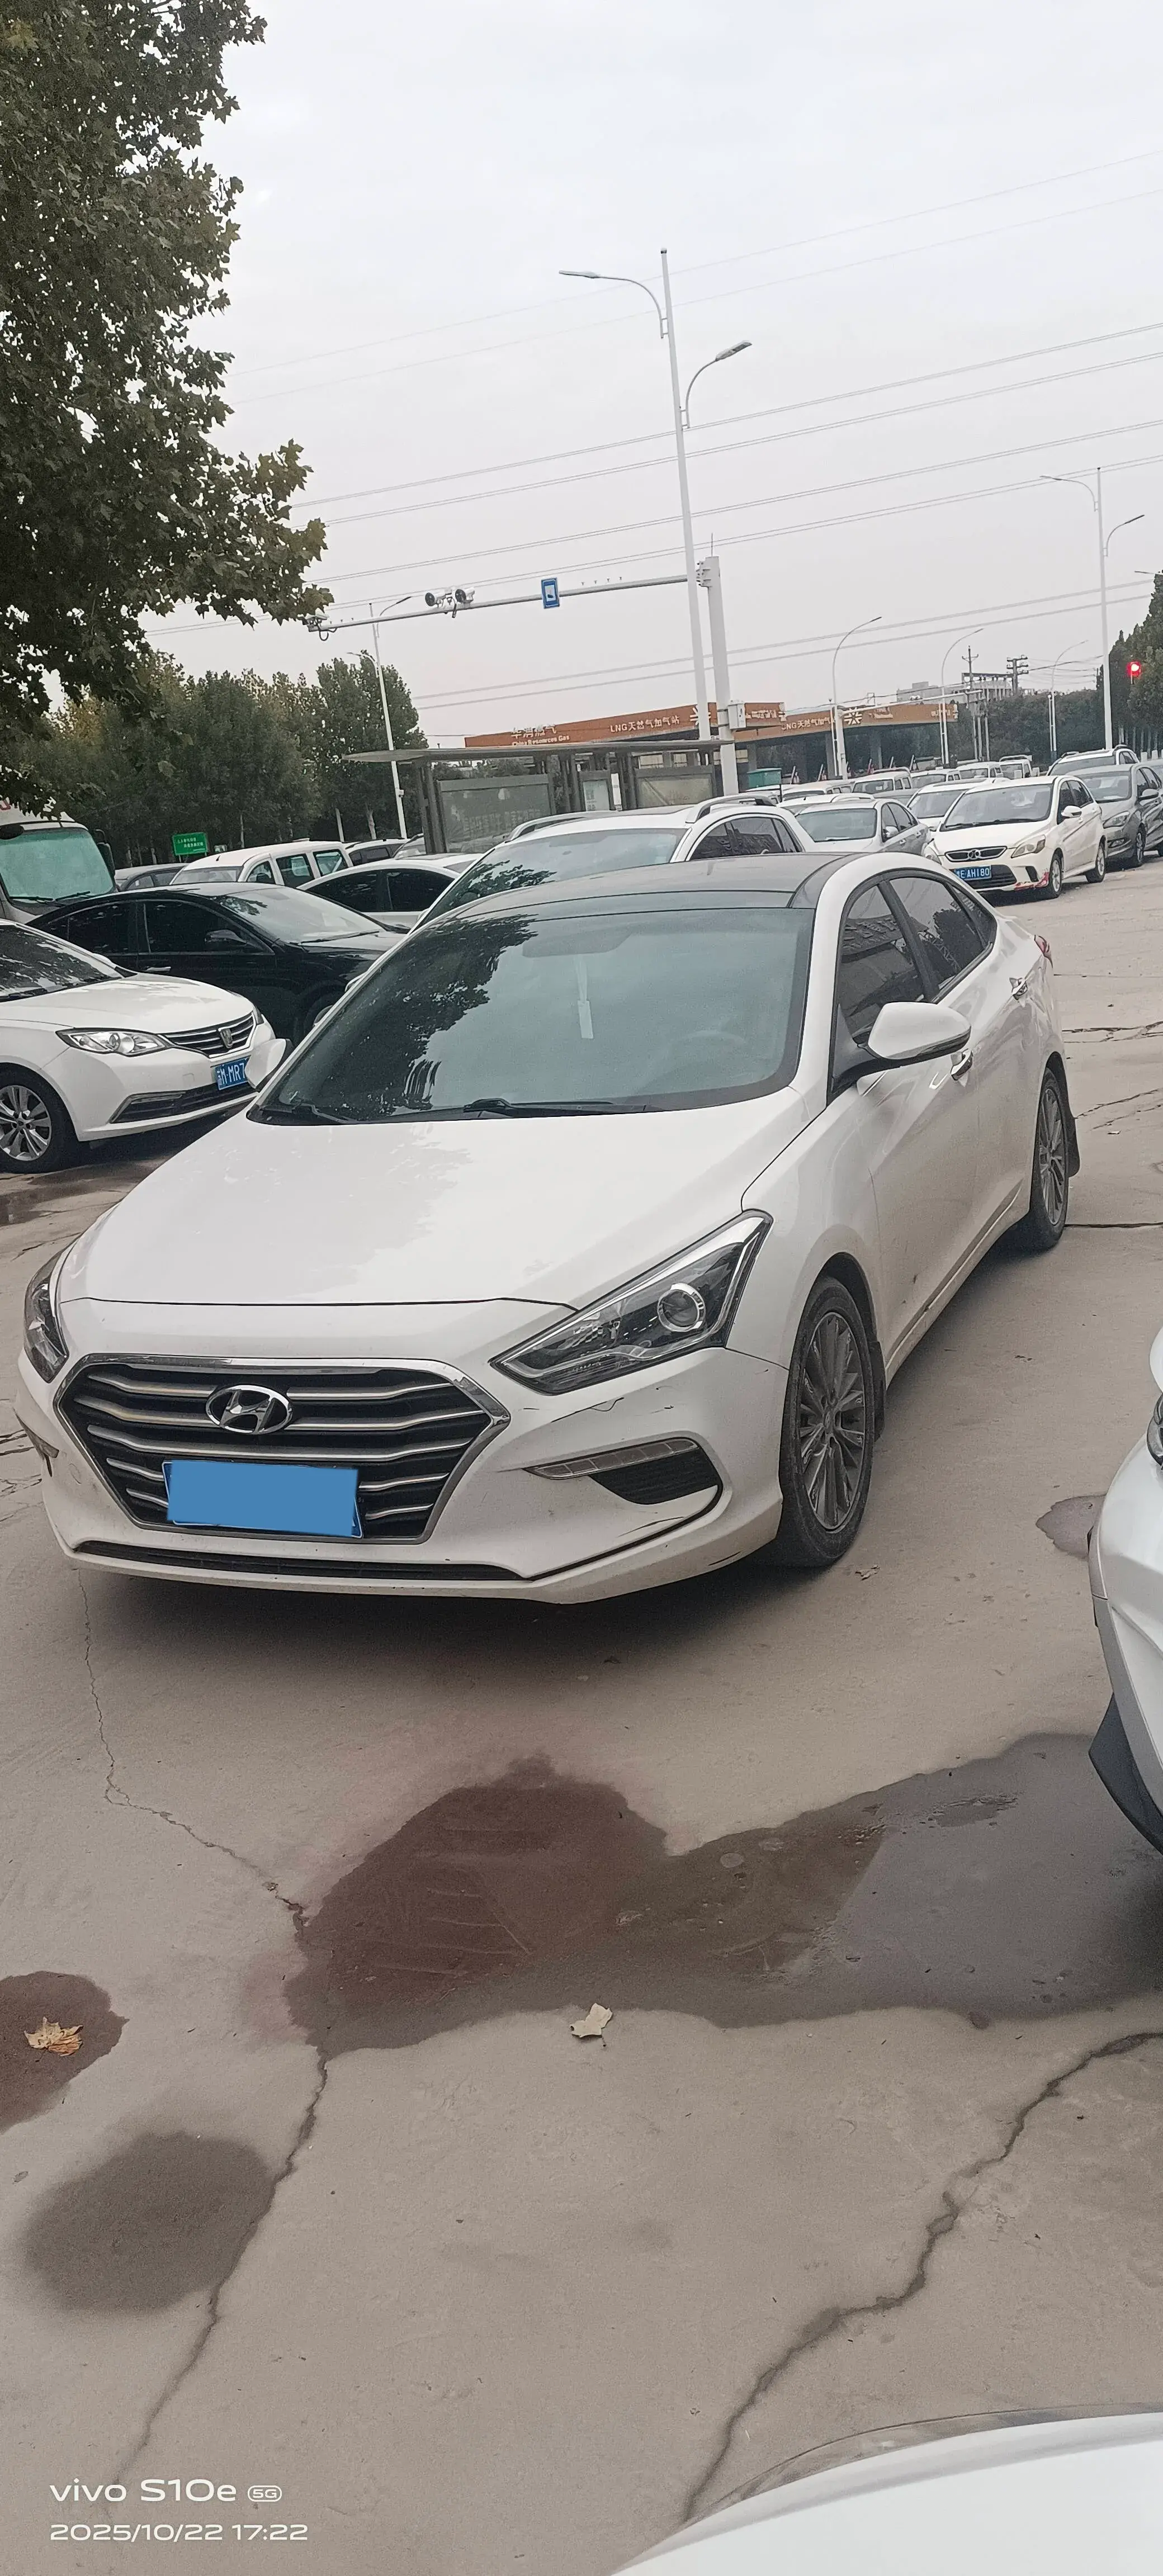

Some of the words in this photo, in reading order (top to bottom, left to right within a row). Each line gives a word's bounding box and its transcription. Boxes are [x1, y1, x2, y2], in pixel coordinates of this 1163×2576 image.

[610, 715, 680, 733] LNG天然气加气站
